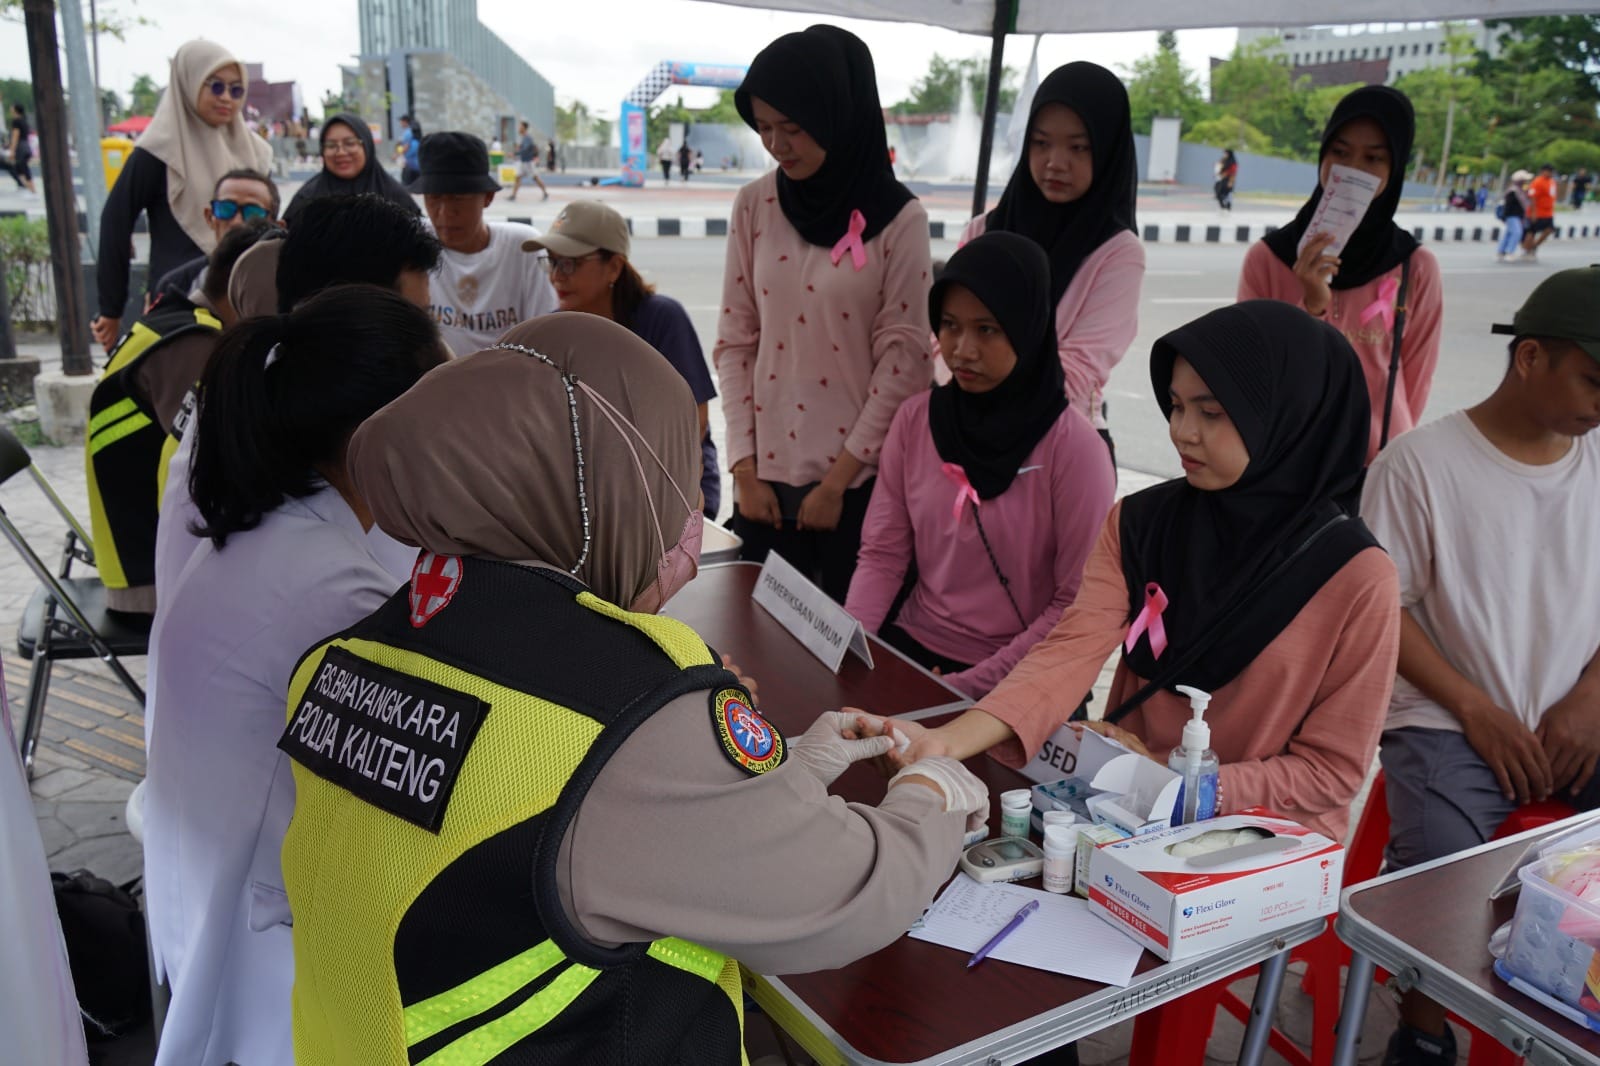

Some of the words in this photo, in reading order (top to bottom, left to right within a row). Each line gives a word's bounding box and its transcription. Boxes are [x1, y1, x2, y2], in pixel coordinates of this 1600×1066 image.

[430, 303, 518, 331] USANTARA
[763, 573, 815, 624] PEMERIKSAAN
[814, 616, 843, 648] UMUM
[313, 663, 461, 749] RS.BHAYANGKARA
[290, 701, 340, 759] POLDA
[338, 724, 446, 803] KALTENG
[1115, 882, 1131, 898] Flexi
[1131, 893, 1151, 911] Glove
[1195, 902, 1214, 915] Flexi
[1214, 898, 1236, 909] Glove
[1106, 899, 1130, 921] POWDER
[1131, 916, 1148, 932] FREE
